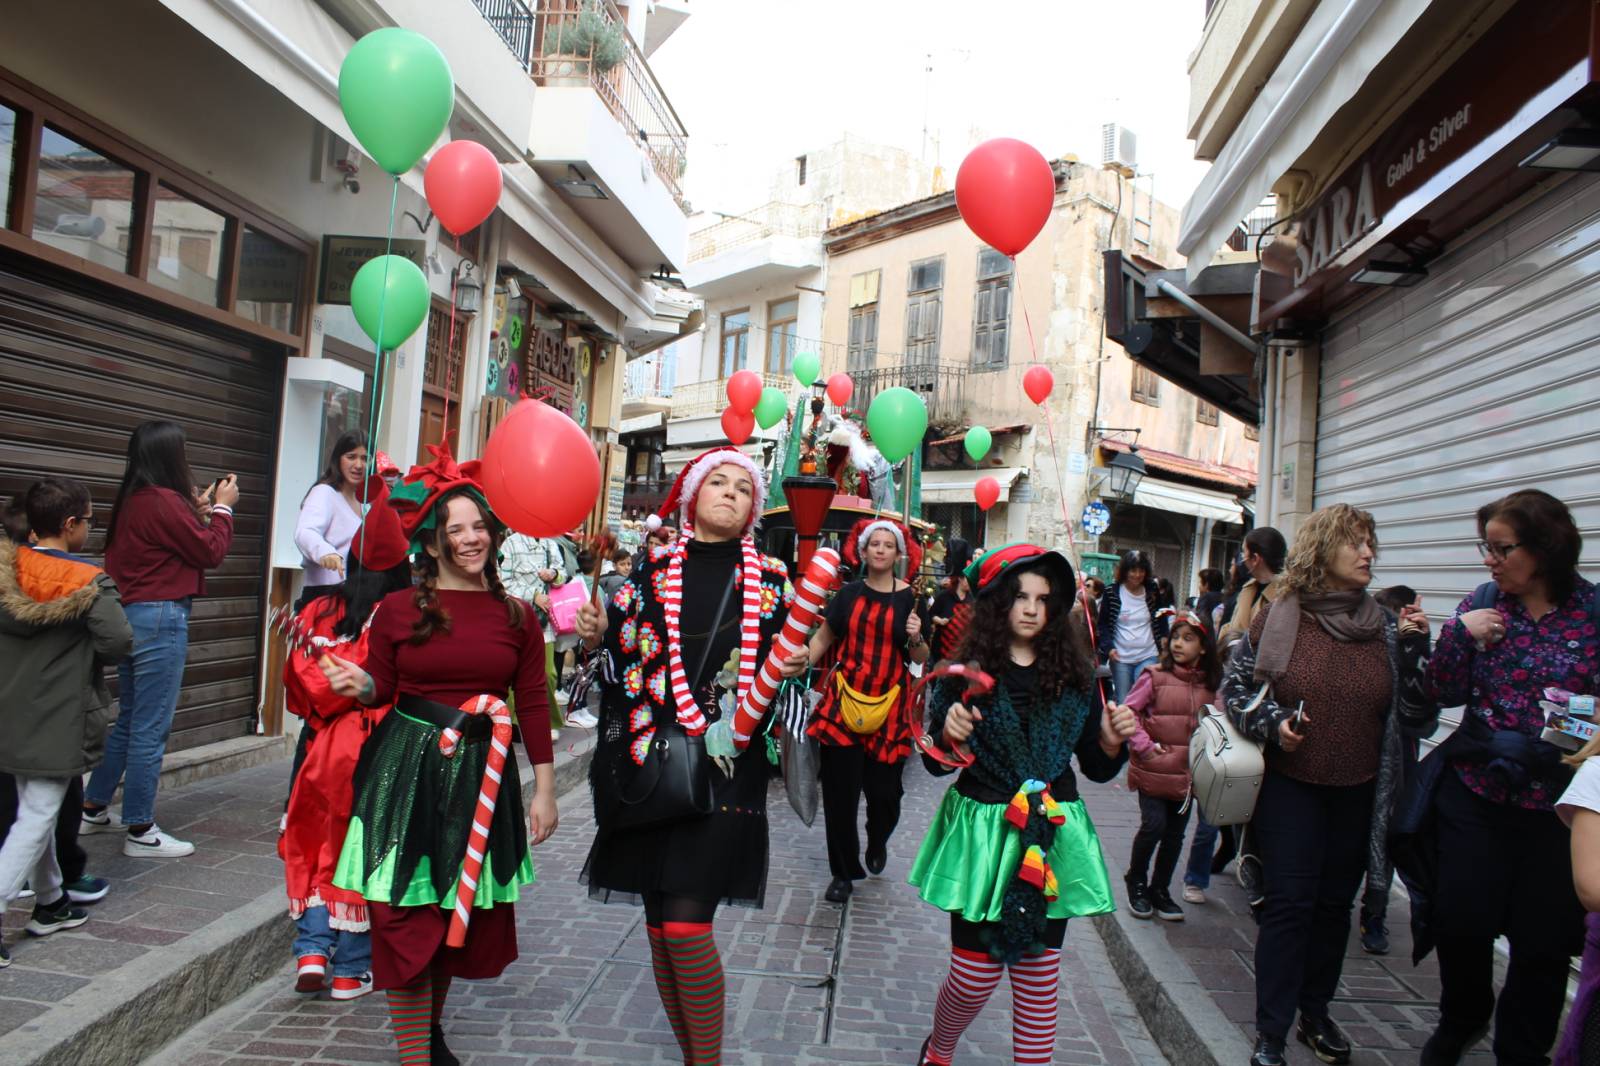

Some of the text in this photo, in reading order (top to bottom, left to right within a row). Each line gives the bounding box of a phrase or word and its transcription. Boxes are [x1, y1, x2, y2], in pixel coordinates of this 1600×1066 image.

[1387, 104, 1471, 187] Gold & Silver
[1294, 162, 1377, 288] SARA
[535, 327, 576, 385] AGORA
